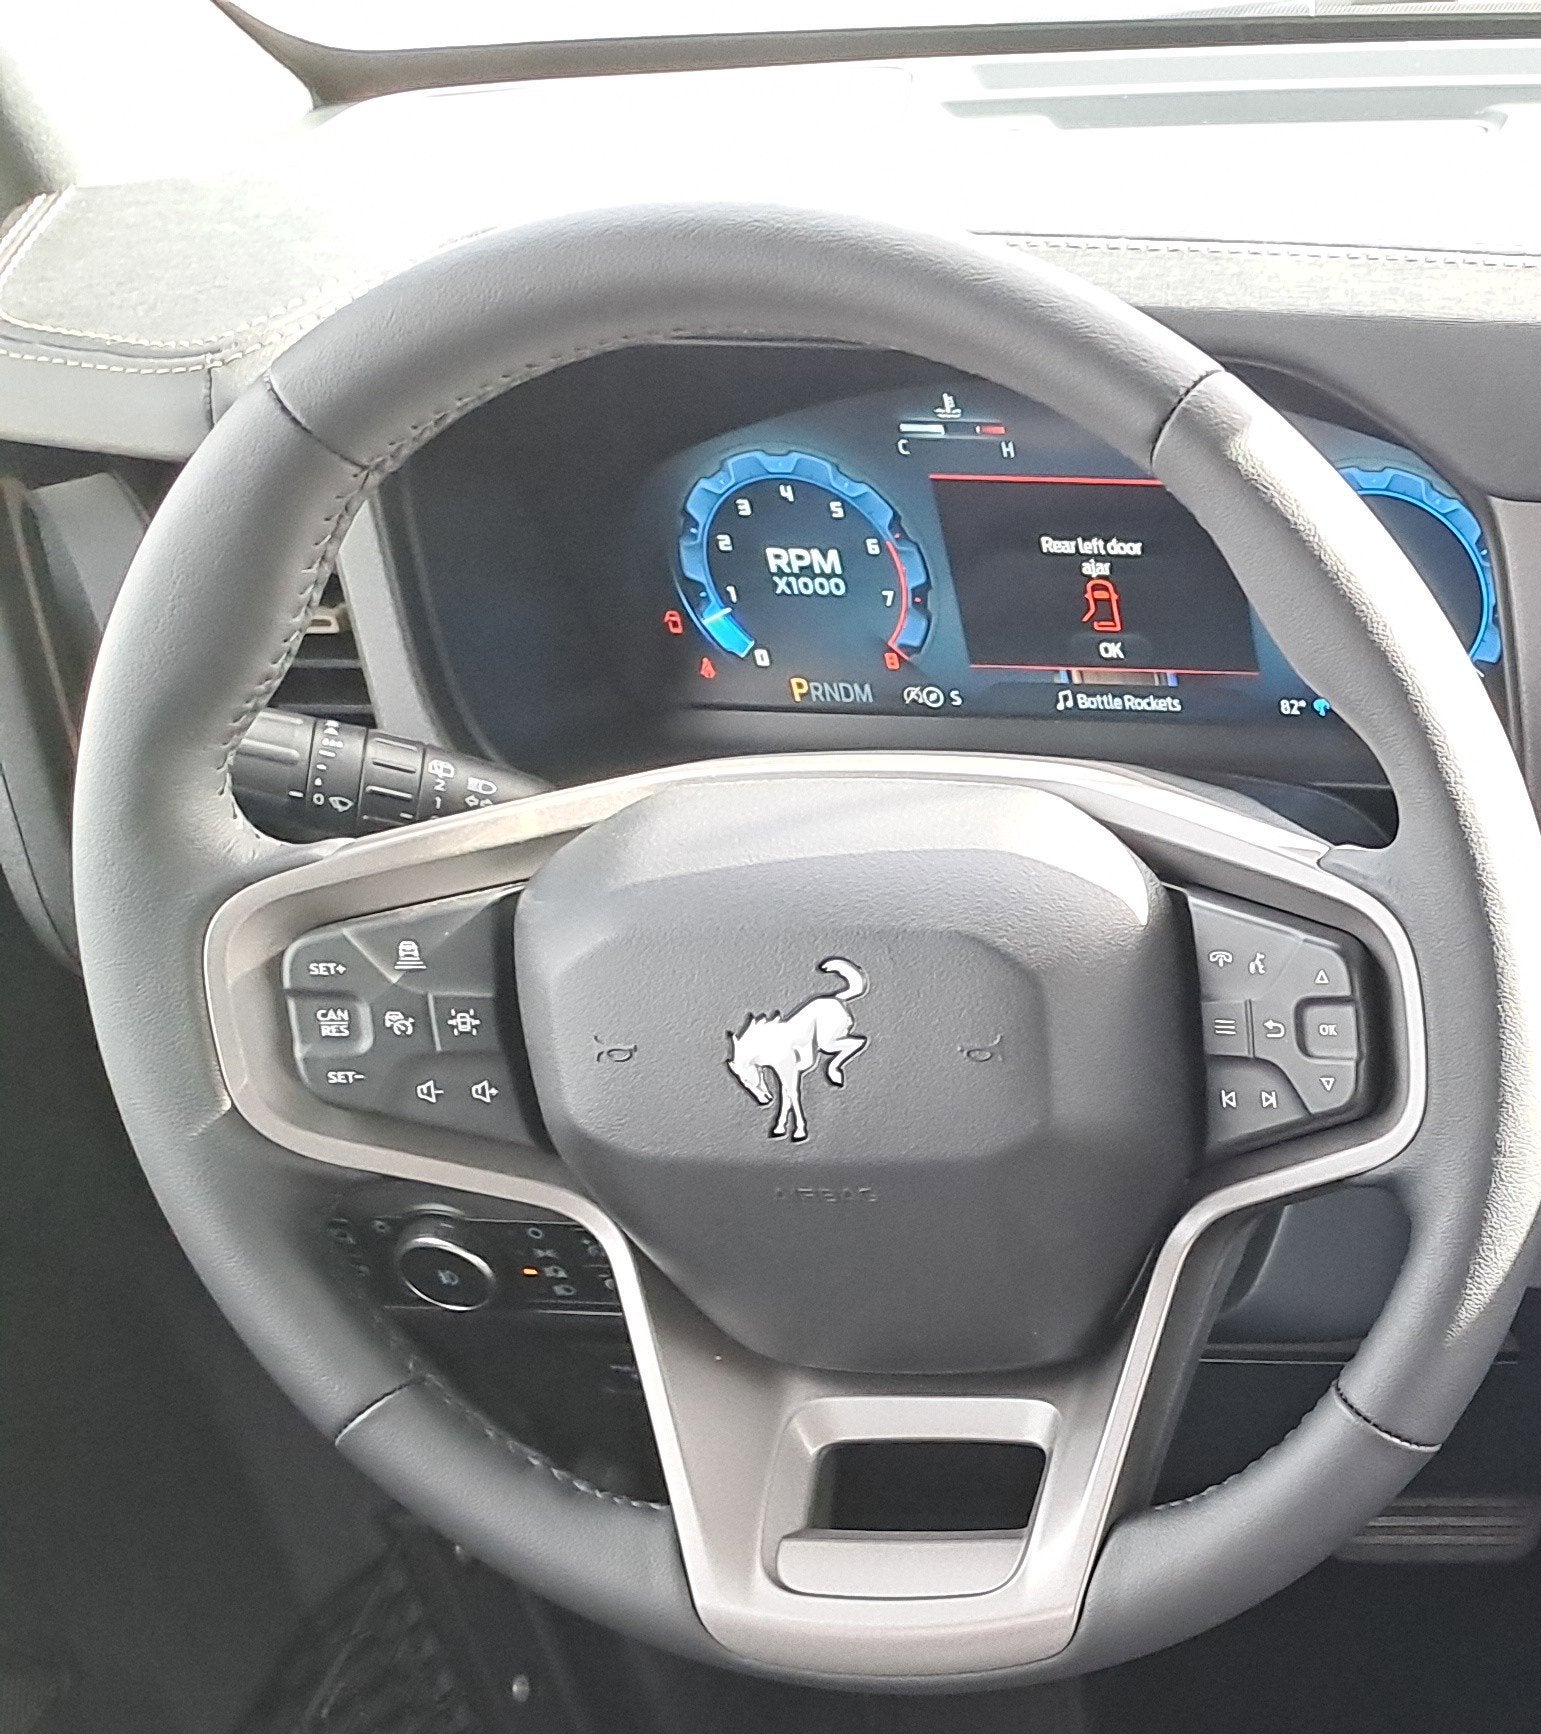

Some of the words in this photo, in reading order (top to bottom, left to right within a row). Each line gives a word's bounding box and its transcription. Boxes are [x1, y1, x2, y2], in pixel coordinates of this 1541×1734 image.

[897, 440, 911, 455] C
[1000, 442, 1015, 459] H
[779, 484, 794, 502] 4
[735, 499, 752, 516] 3
[829, 501, 845, 518] 5
[716, 534, 733, 551] 2
[866, 538, 880, 555] 6
[1040, 536, 1076, 555] Rear
[1078, 537, 1105, 555] left
[1107, 538, 1143, 556] door
[765, 547, 842, 575] RPM
[1081, 560, 1111, 577] ajar
[726, 586, 738, 603] 1
[773, 576, 846, 596] X1000
[882, 590, 895, 606] 7
[754, 649, 770, 667] 0
[1099, 642, 1125, 659] OK
[884, 652, 900, 670] 8
[1076, 693, 1123, 710] Bottle
[1124, 695, 1182, 712] Rockets
[309, 962, 347, 976] SET+
[316, 1008, 349, 1022] CAN
[320, 1024, 350, 1038] RES
[1319, 1024, 1338, 1036] OK
